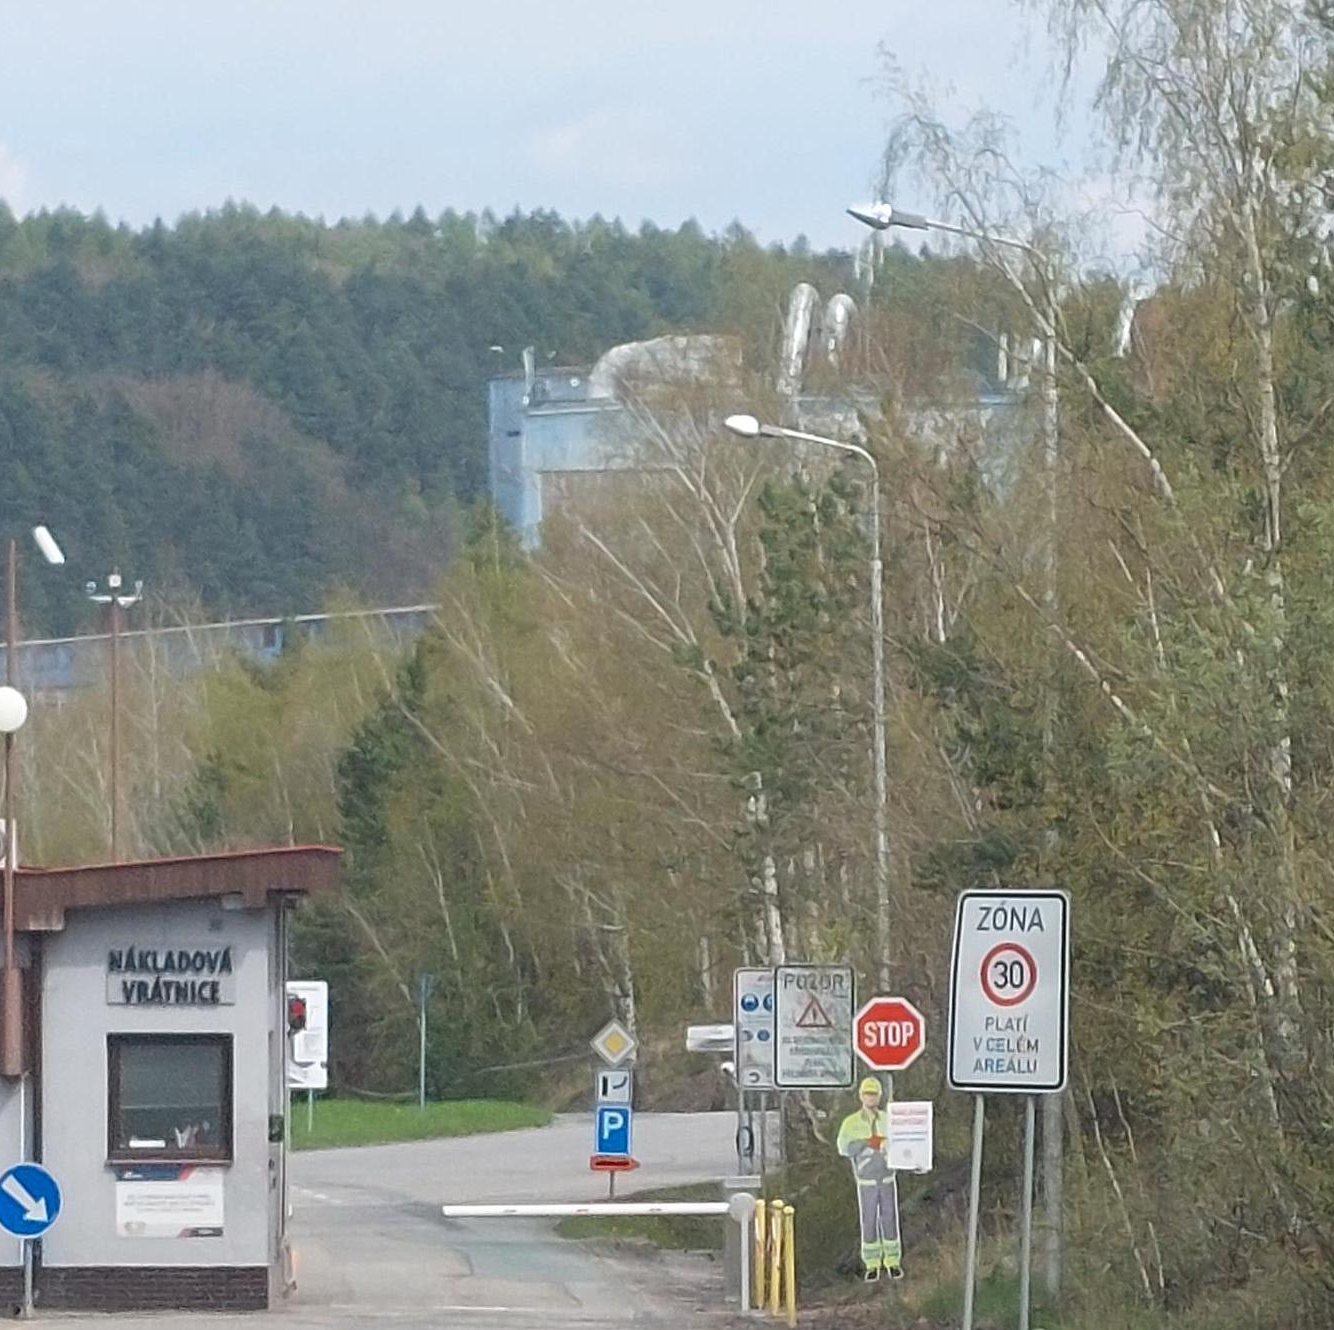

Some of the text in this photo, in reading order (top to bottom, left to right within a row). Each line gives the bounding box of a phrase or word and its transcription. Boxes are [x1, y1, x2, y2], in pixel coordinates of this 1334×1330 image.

[976, 901, 1044, 932] ZÓNA
[108, 944, 232, 974] NÁKLADOVÁ
[993, 960, 1024, 989] 30
[122, 975, 220, 1003] VRÁTNICE
[864, 1021, 915, 1047] STOP
[985, 1014, 1028, 1032] PLATÍ
[973, 1034, 1039, 1054] V CELÉM
[973, 1056, 1038, 1074] AREÁLU
[603, 1111, 624, 1140] P
